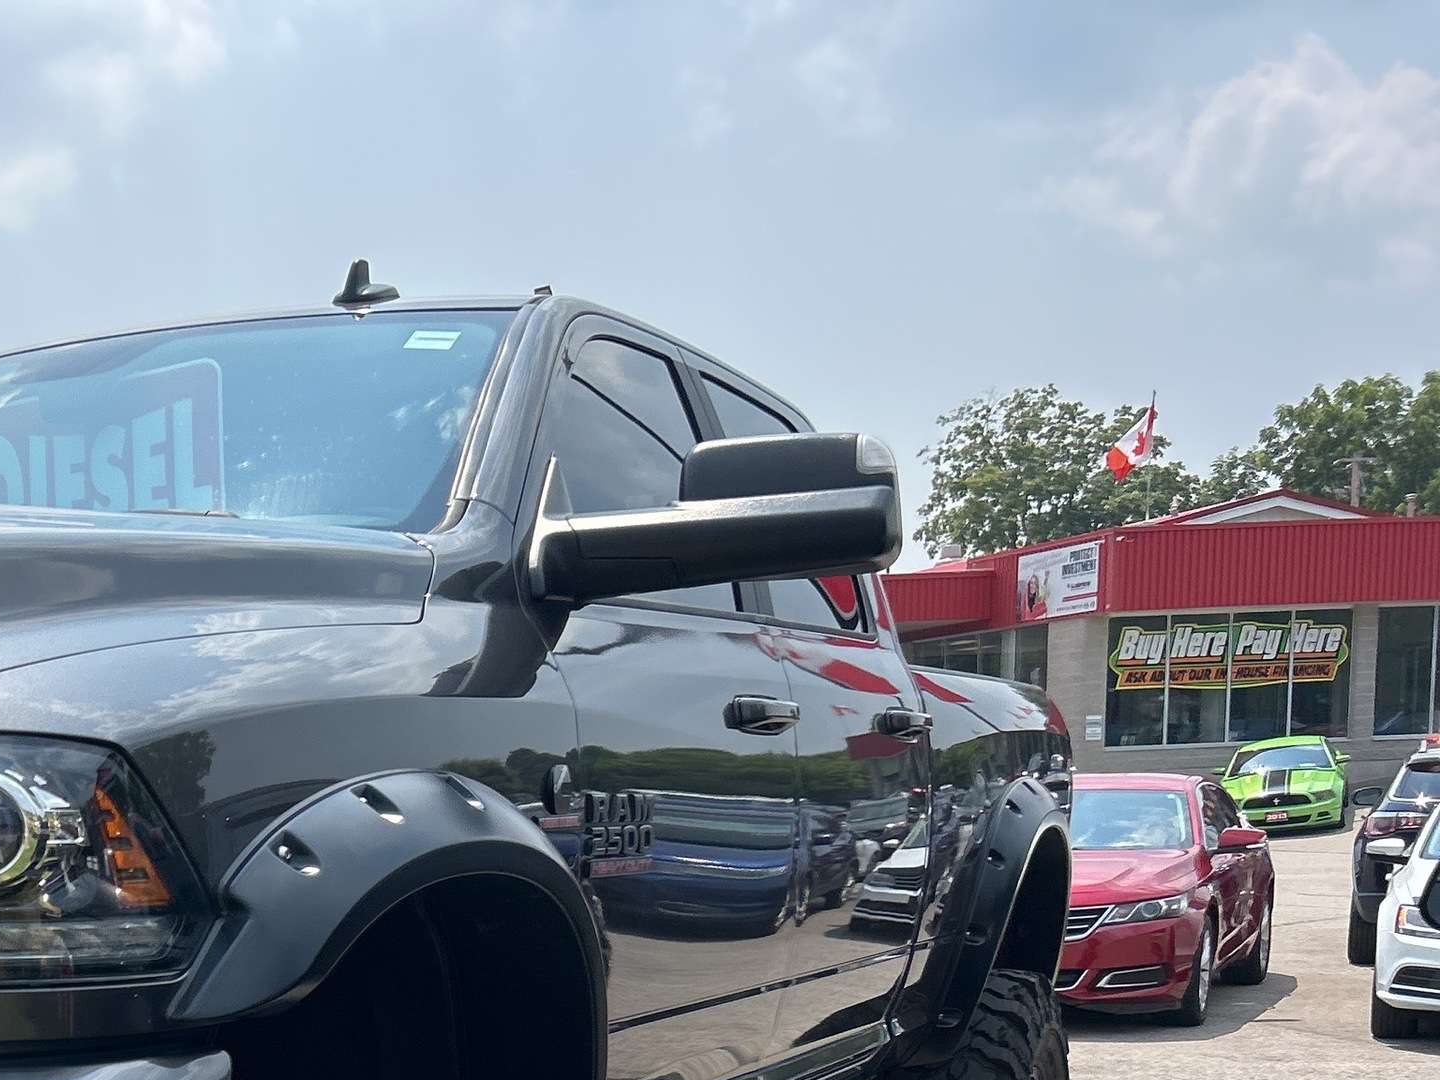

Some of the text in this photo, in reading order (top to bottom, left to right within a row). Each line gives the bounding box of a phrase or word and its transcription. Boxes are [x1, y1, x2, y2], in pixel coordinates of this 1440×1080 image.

[1119, 623, 1343, 664] Buy Here Pay Here
[1125, 670, 1148, 683] ASK
[1189, 668, 1212, 681] OUR
[586, 793, 655, 822] RAM
[1266, 813, 1288, 821] 2013
[590, 825, 653, 856] 2500
